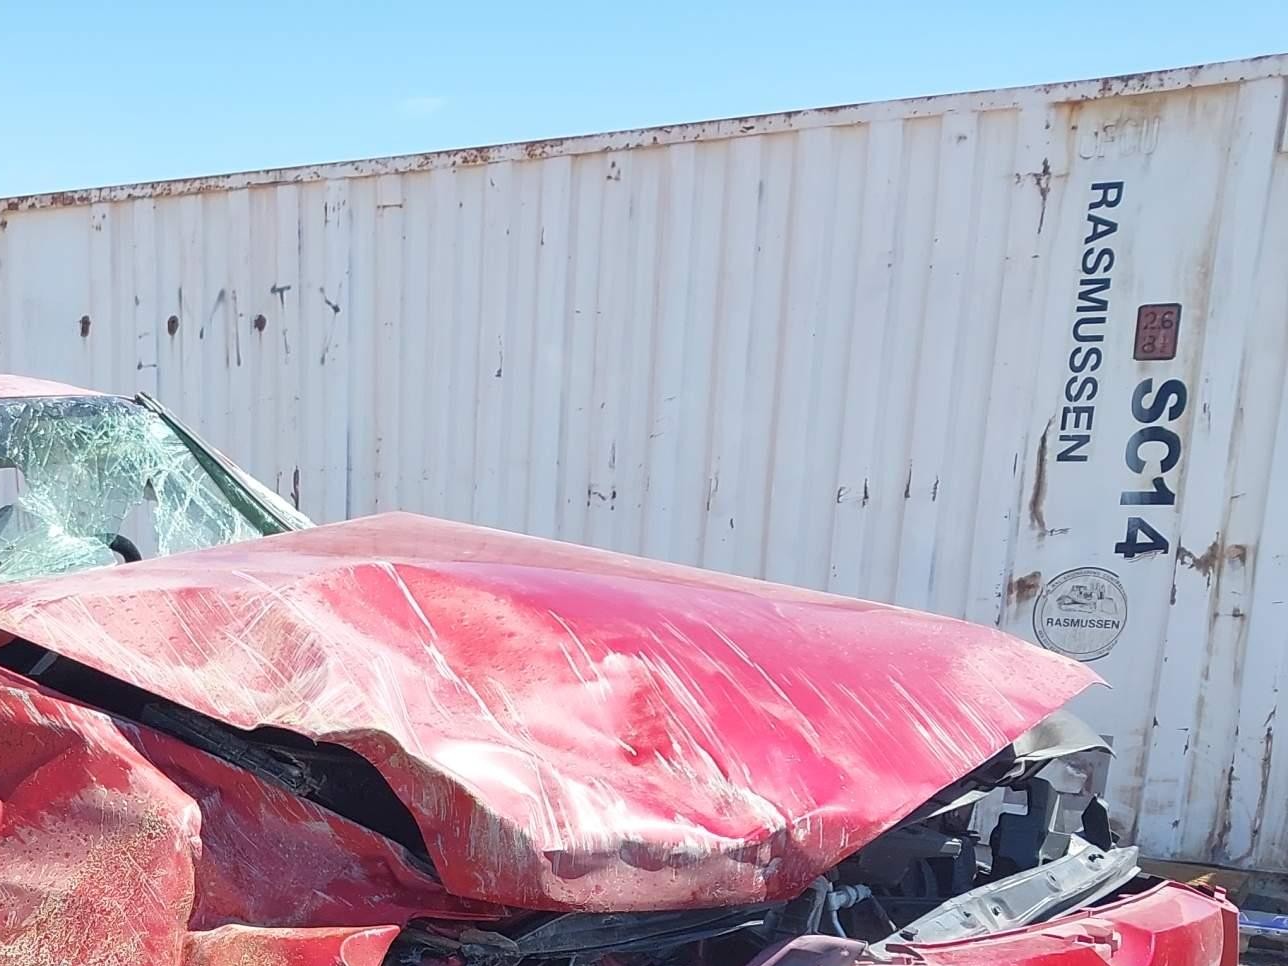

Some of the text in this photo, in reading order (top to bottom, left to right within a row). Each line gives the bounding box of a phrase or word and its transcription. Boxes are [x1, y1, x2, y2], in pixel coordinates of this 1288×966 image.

[1055, 181, 1124, 462] RASMUSSEN
[1114, 377, 1188, 558] SC14
[1046, 617, 1120, 630] RASMUSSEN
